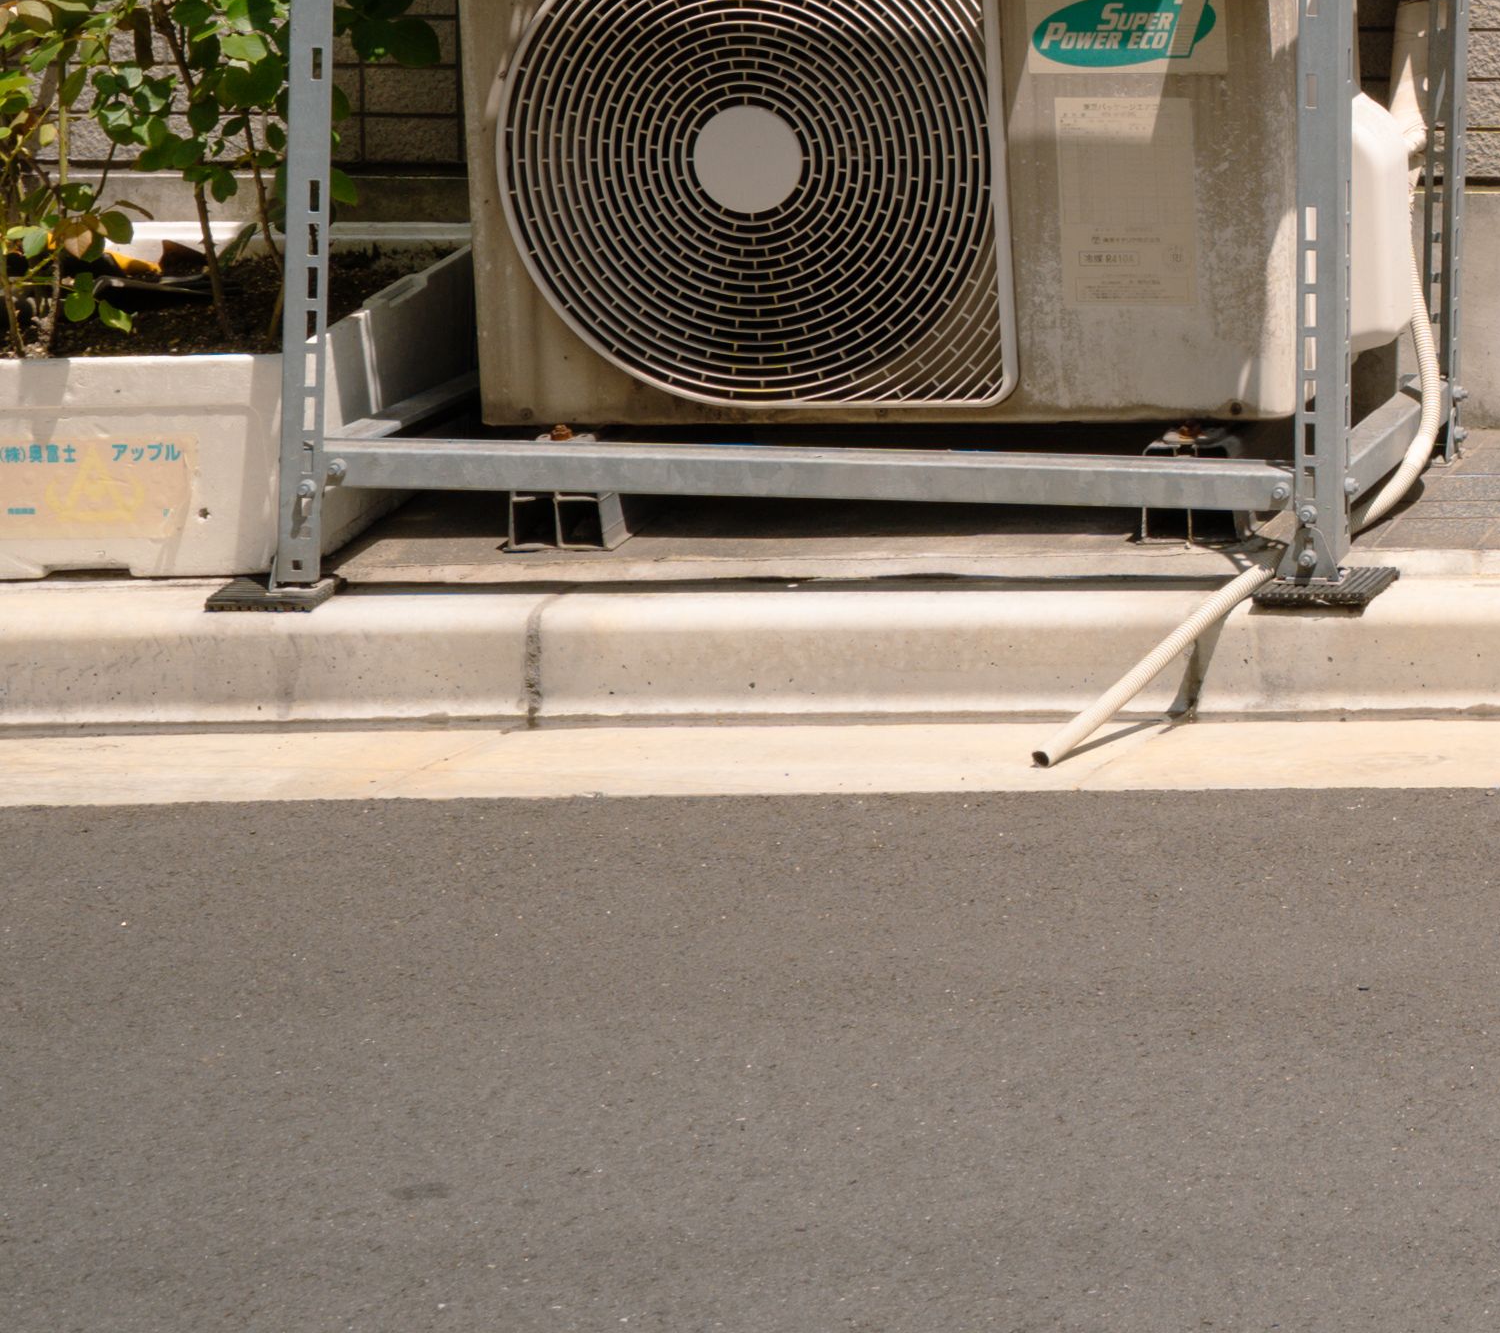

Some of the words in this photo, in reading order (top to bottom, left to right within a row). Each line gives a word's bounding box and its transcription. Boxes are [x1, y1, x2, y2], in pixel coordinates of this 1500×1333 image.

[1096, 3, 1174, 31] SUPER
[1040, 22, 1123, 49] POWER
[1127, 32, 1169, 49] ECO
[111, 442, 182, 462] アップル
